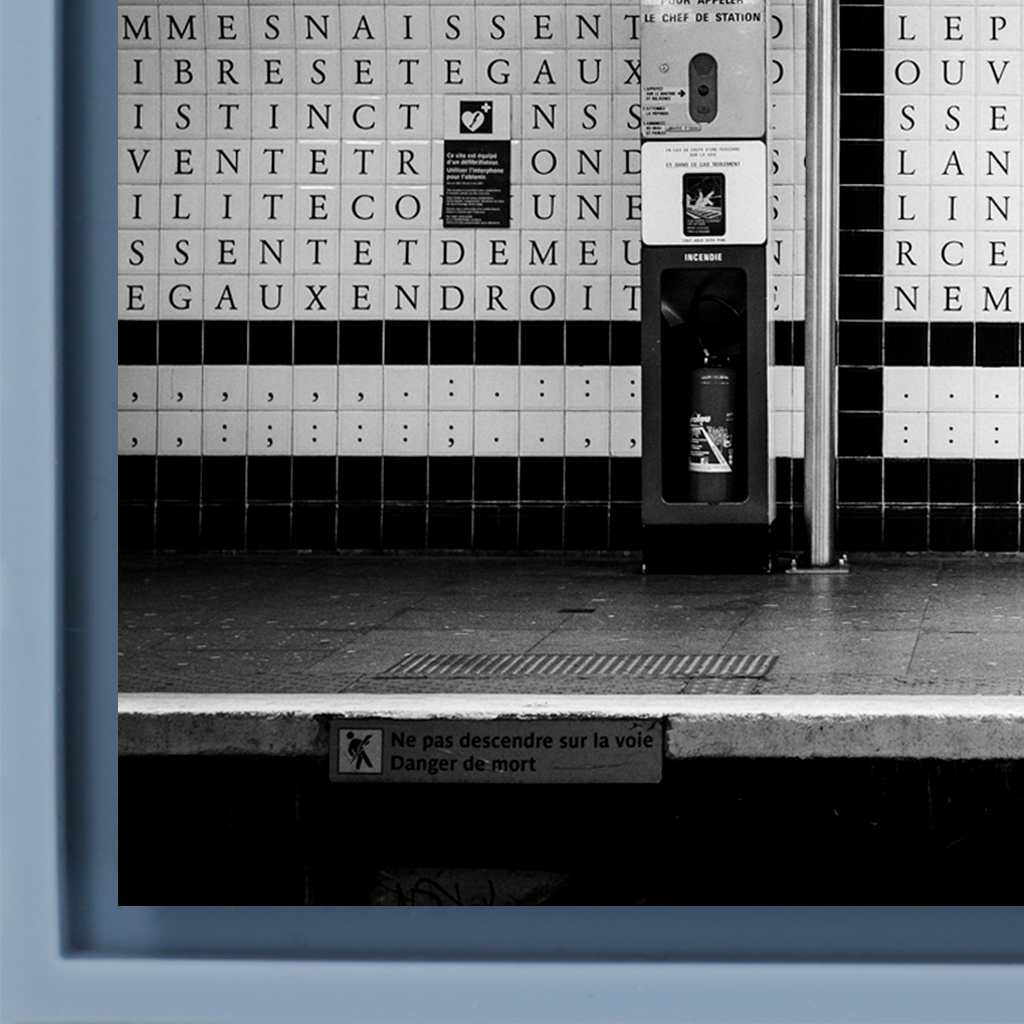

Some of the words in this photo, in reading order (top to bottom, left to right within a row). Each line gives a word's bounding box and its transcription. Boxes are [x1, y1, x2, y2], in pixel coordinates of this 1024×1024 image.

[644, 13, 656, 23] LE
[662, 13, 690, 23] CHEF
[695, 12, 709, 22] DE
[715, 12, 761, 22] STATION
[684, 252, 723, 262] INCENDIE
[390, 731, 416, 749] Ne
[423, 735, 453, 751] pas
[459, 731, 553, 749] descendre
[559, 735, 587, 749] sur
[593, 731, 609, 749] la
[615, 731, 654, 749] voie
[390, 755, 457, 775] Danger
[463, 754, 485, 772] de
[491, 756, 537, 773] mort
